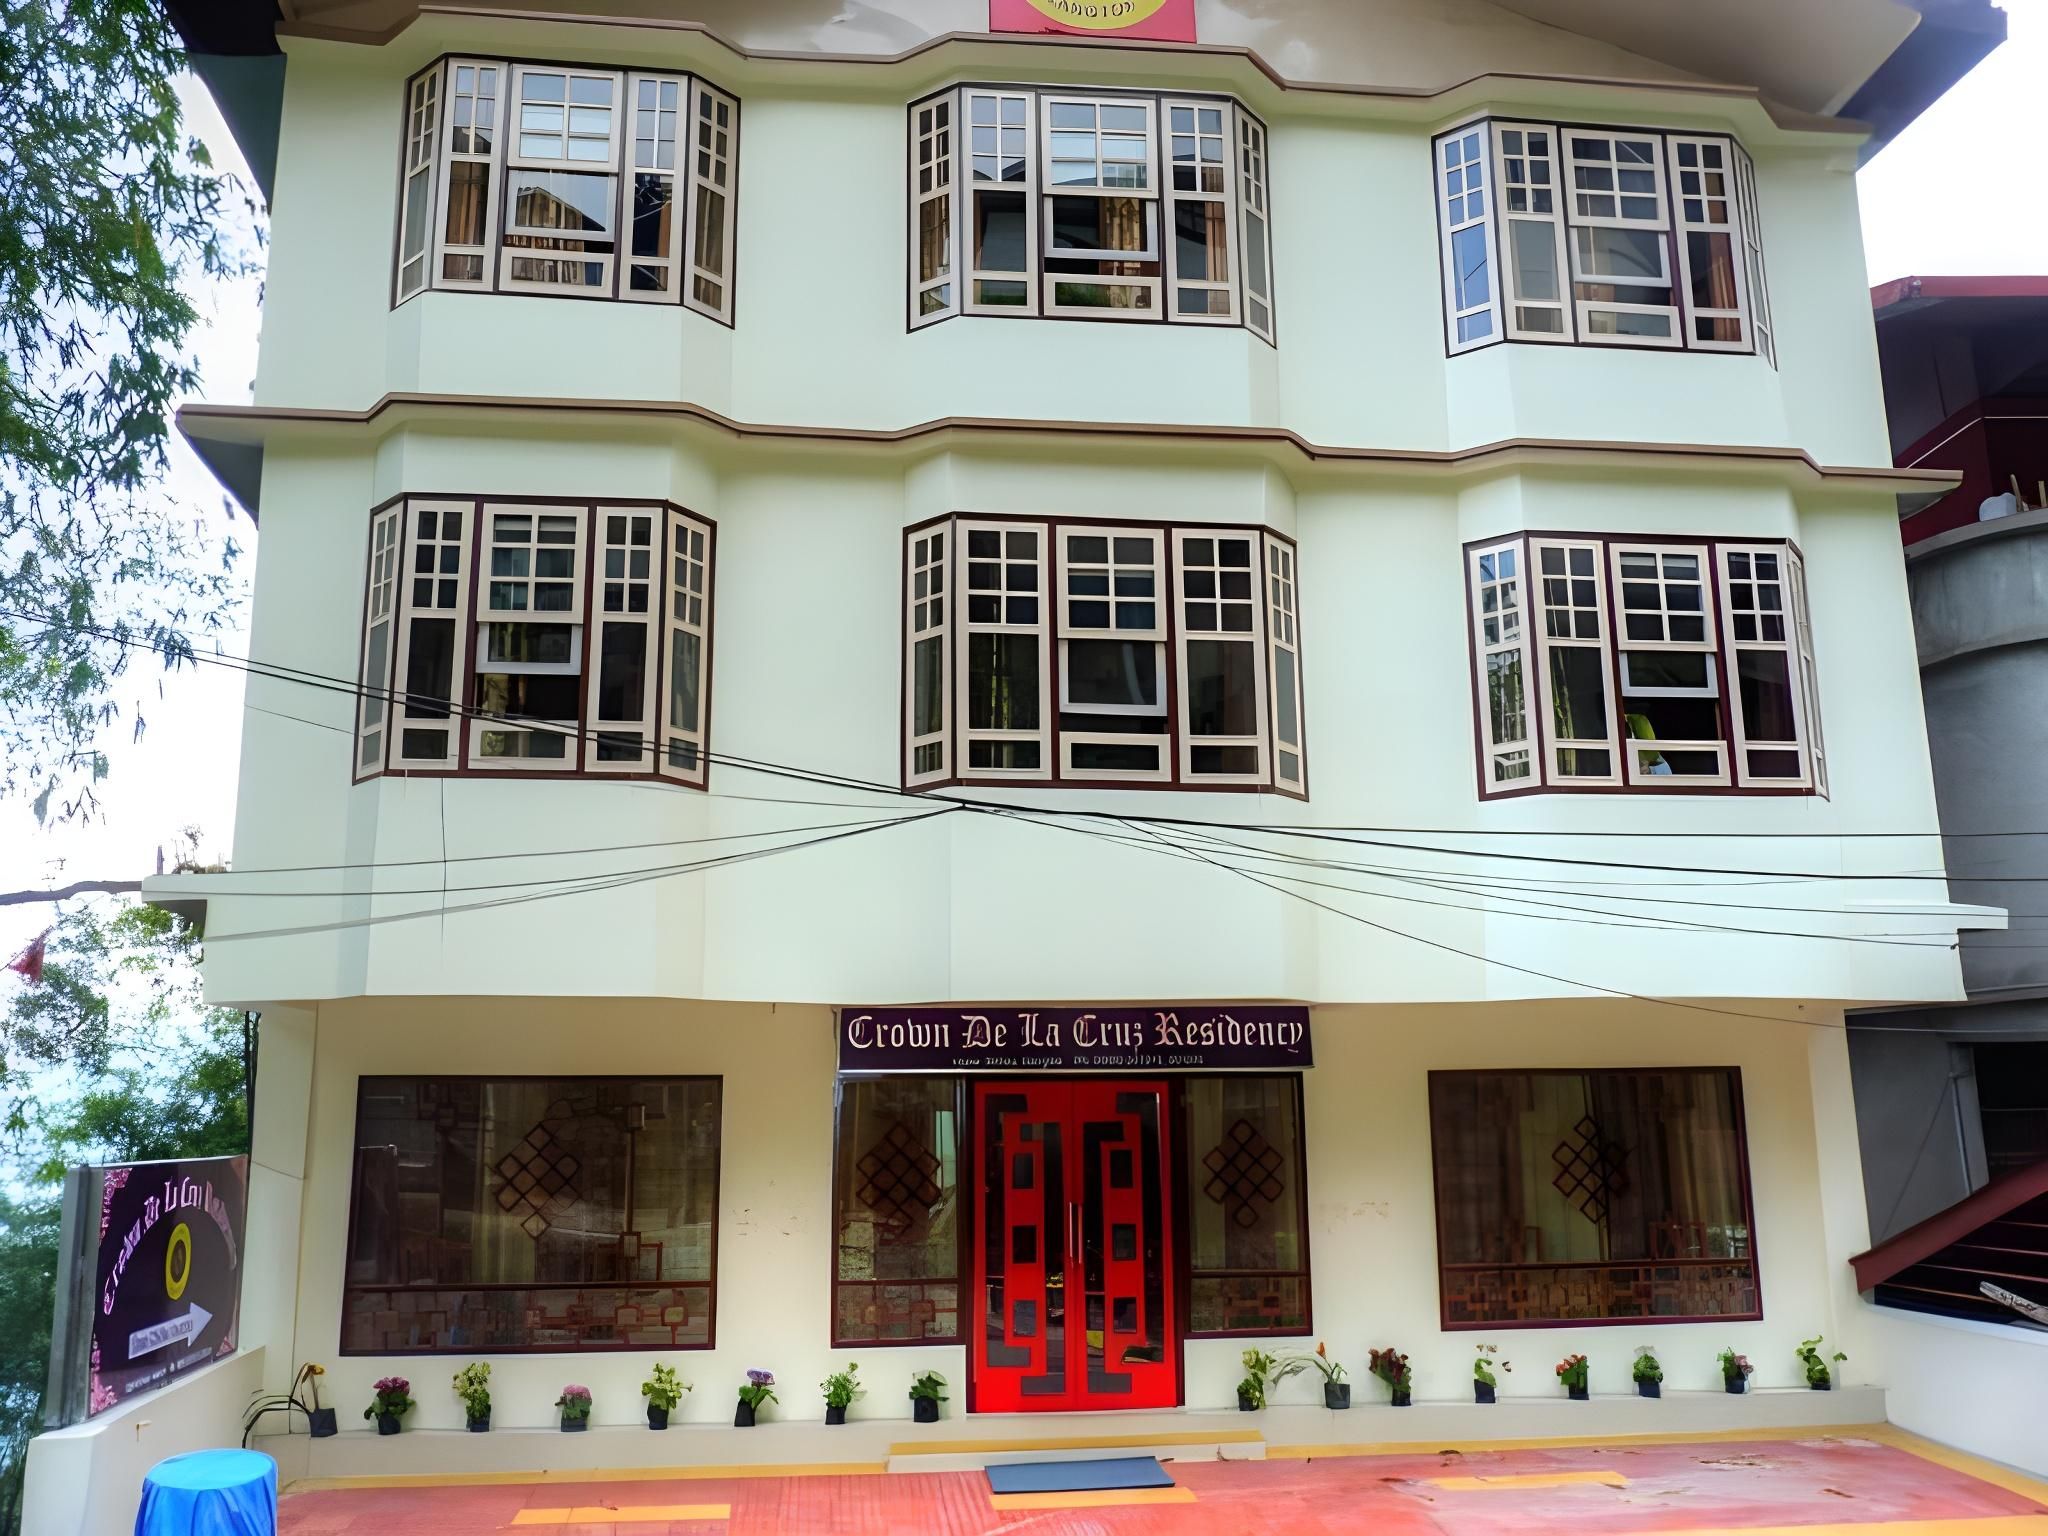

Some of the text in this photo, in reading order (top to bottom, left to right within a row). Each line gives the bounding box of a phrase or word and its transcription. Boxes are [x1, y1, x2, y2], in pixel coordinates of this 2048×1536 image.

[848, 1011, 1304, 1054] Crown De La Cruz Residency
